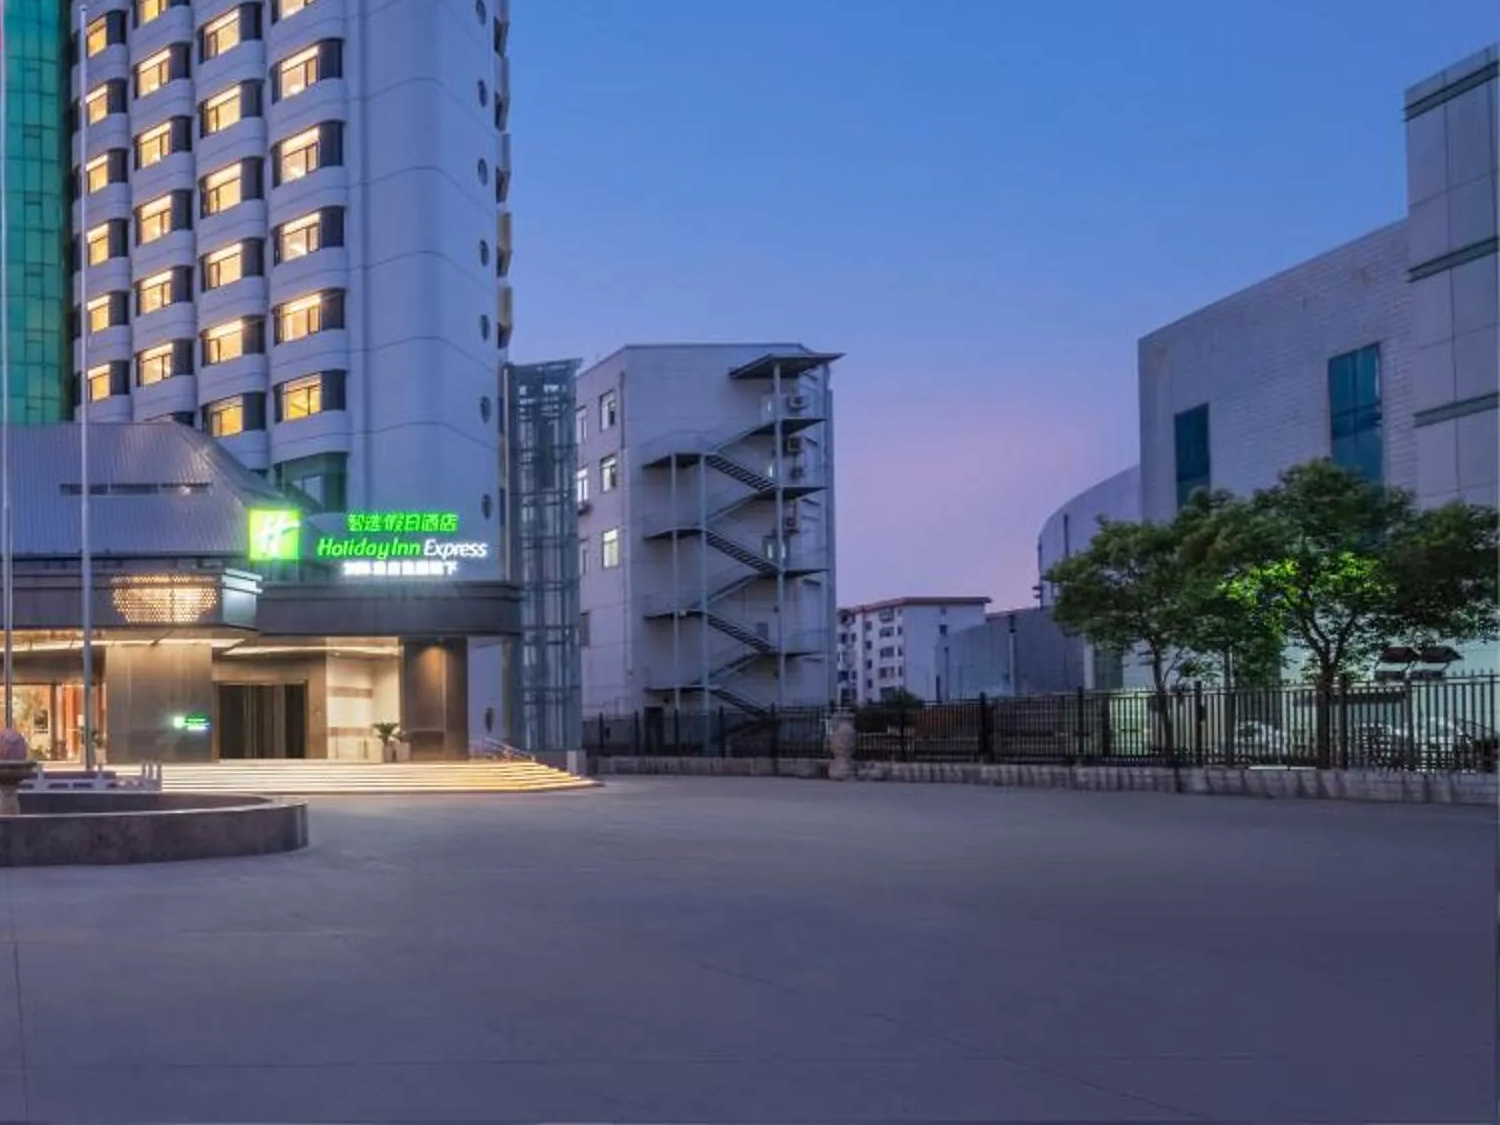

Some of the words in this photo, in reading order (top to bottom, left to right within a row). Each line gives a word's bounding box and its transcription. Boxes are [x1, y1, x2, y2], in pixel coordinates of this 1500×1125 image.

[348, 513, 459, 534] 智选假日酒店
[318, 538, 390, 560] Holiday
[392, 539, 421, 556] Inn
[423, 539, 488, 561] Express
